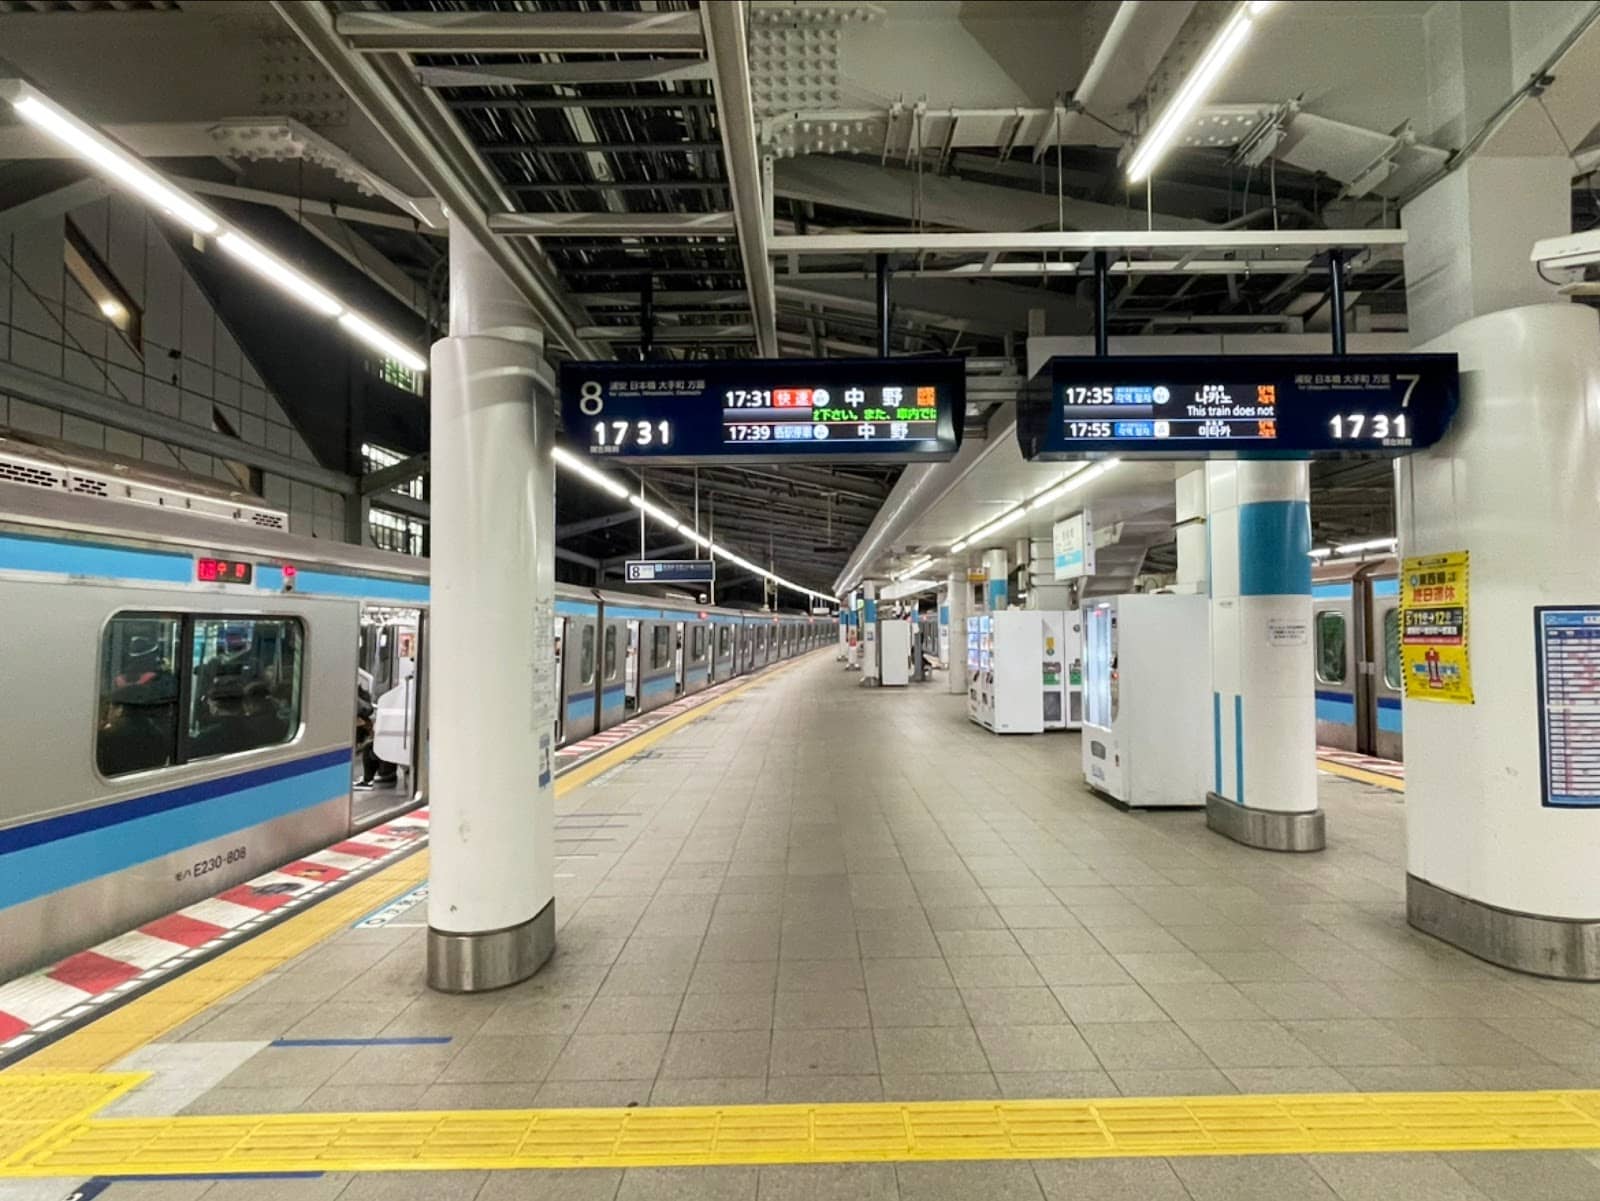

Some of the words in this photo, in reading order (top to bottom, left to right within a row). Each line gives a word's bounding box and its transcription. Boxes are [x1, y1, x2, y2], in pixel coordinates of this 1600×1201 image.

[580, 381, 603, 415] 8
[726, 390, 771, 408] 17:31
[1066, 387, 1113, 404] 17:35
[1396, 374, 1420, 408] 7
[1187, 404, 1206, 417] This
[1208, 404, 1231, 417] train
[1232, 404, 1256, 417] does
[1257, 405, 1275, 417] not
[729, 425, 771, 441] 17:39
[1070, 422, 1111, 438] 17:55
[632, 567, 640, 577] 8
